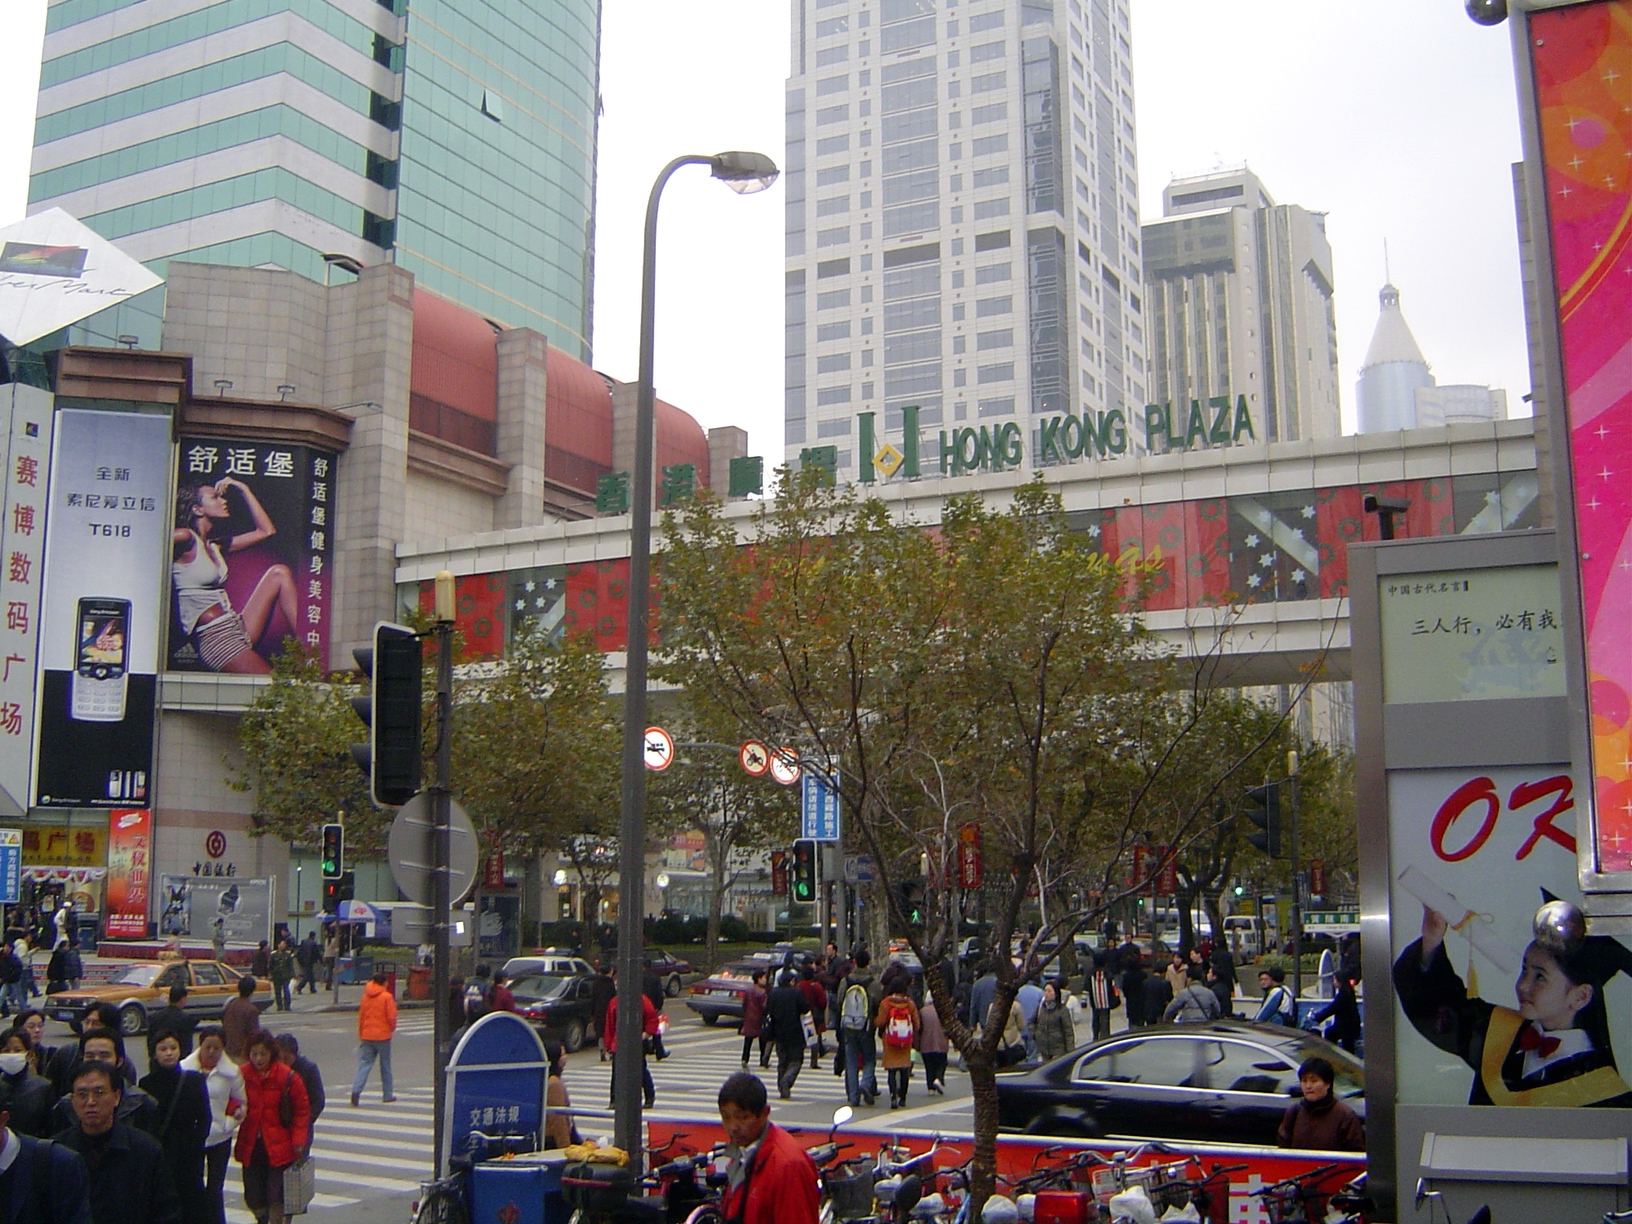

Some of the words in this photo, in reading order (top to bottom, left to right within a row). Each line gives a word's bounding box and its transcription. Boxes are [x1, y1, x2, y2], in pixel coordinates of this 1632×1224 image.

[939, 421, 1023, 477] HONG
[1040, 407, 1126, 463] KONG
[1144, 393, 1255, 451] PLAZA
[188, 445, 294, 478] 舒适堡
[96, 466, 131, 482] 全新
[67, 493, 155, 512] 索尼爱立信
[89, 523, 131, 538] T618
[0, 455, 38, 736] 赛博数码广场
[1388, 580, 1461, 596] 中国古代名言
[470, 1106, 520, 1127] 交通法规
